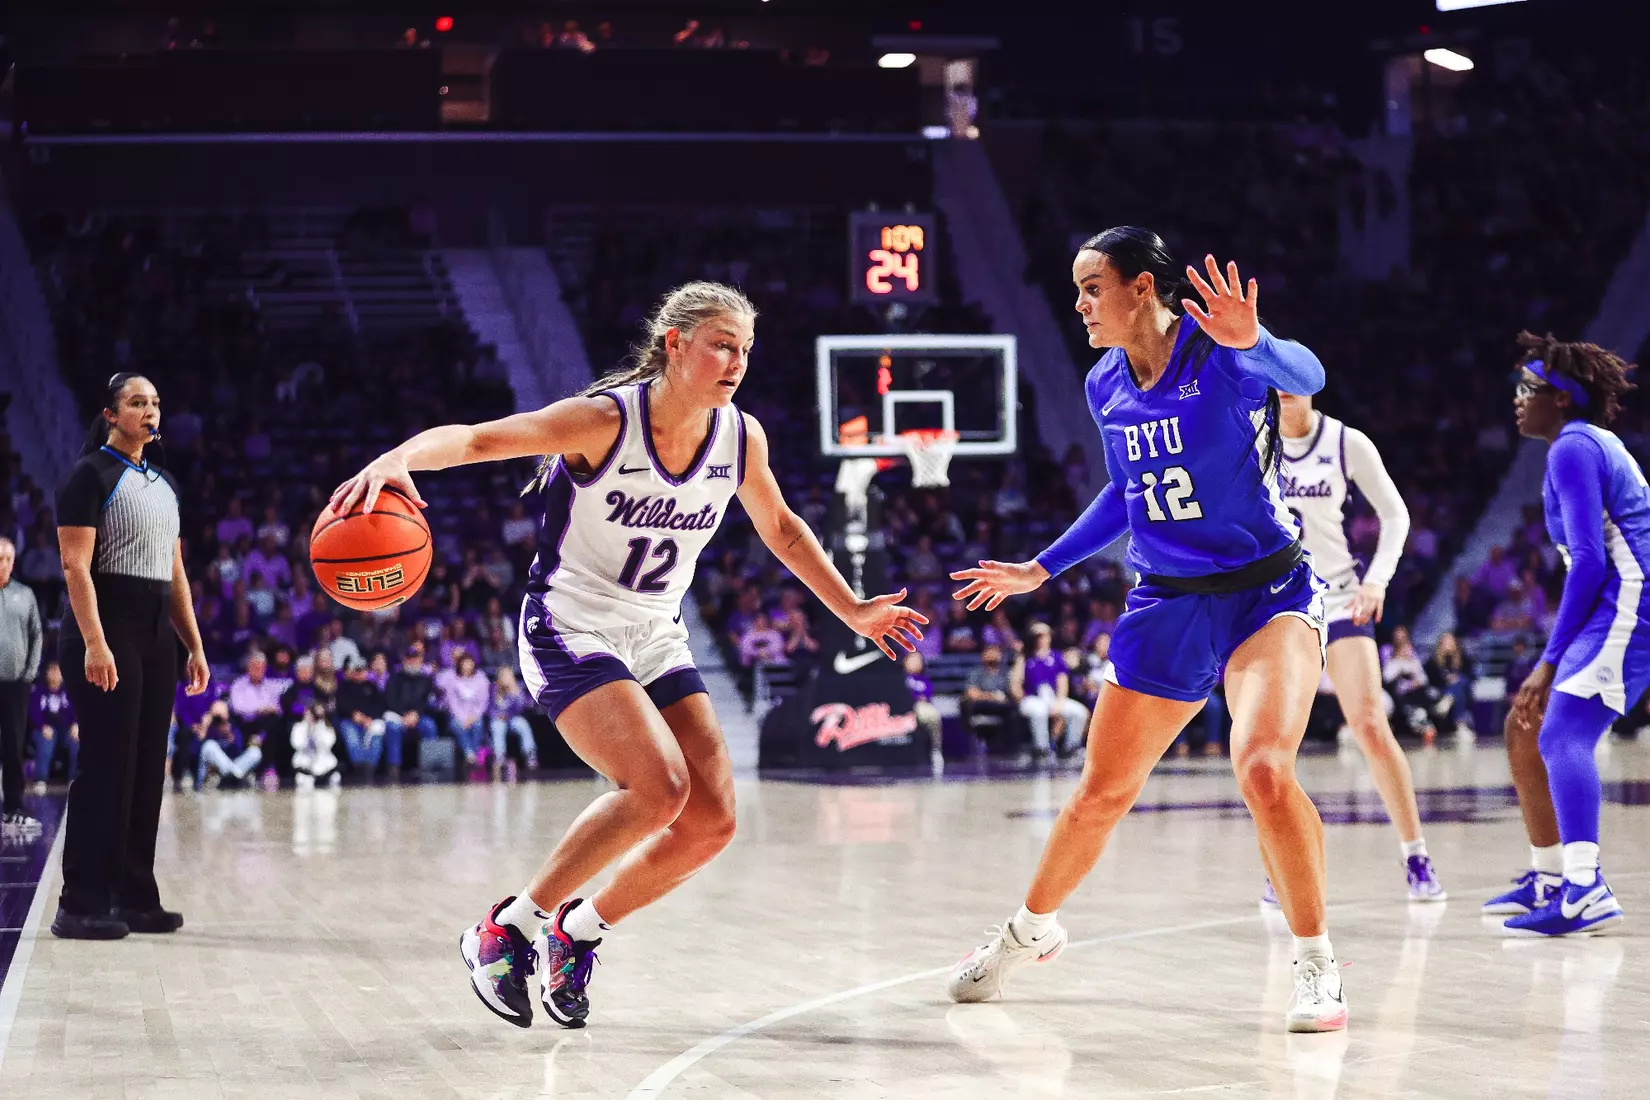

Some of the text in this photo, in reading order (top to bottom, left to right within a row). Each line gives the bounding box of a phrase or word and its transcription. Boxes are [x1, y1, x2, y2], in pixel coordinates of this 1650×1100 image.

[1128, 17, 1184, 56] 15
[866, 249, 919, 294] 24
[1123, 416, 1184, 462] BYU
[605, 489, 718, 531] Wildcats
[1140, 465, 1204, 522] 12
[334, 567, 404, 594] ELITE
[616, 535, 680, 594] 12
